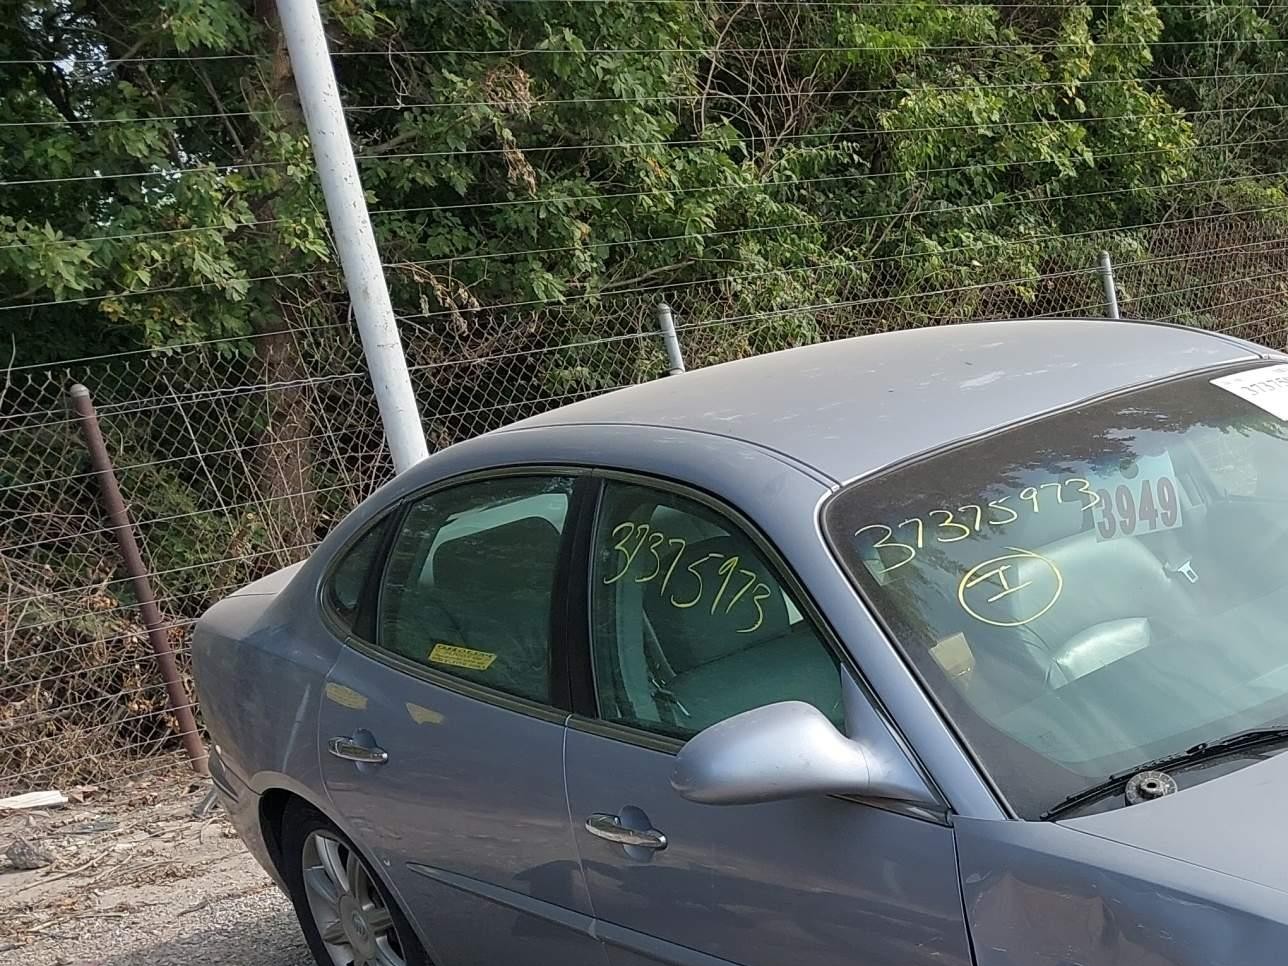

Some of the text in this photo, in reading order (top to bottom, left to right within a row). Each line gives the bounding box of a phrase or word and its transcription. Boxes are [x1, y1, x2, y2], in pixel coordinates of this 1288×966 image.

[854, 478, 1101, 575] 37375973
[1096, 476, 1178, 539] 3949
[603, 521, 772, 633] 37375973
